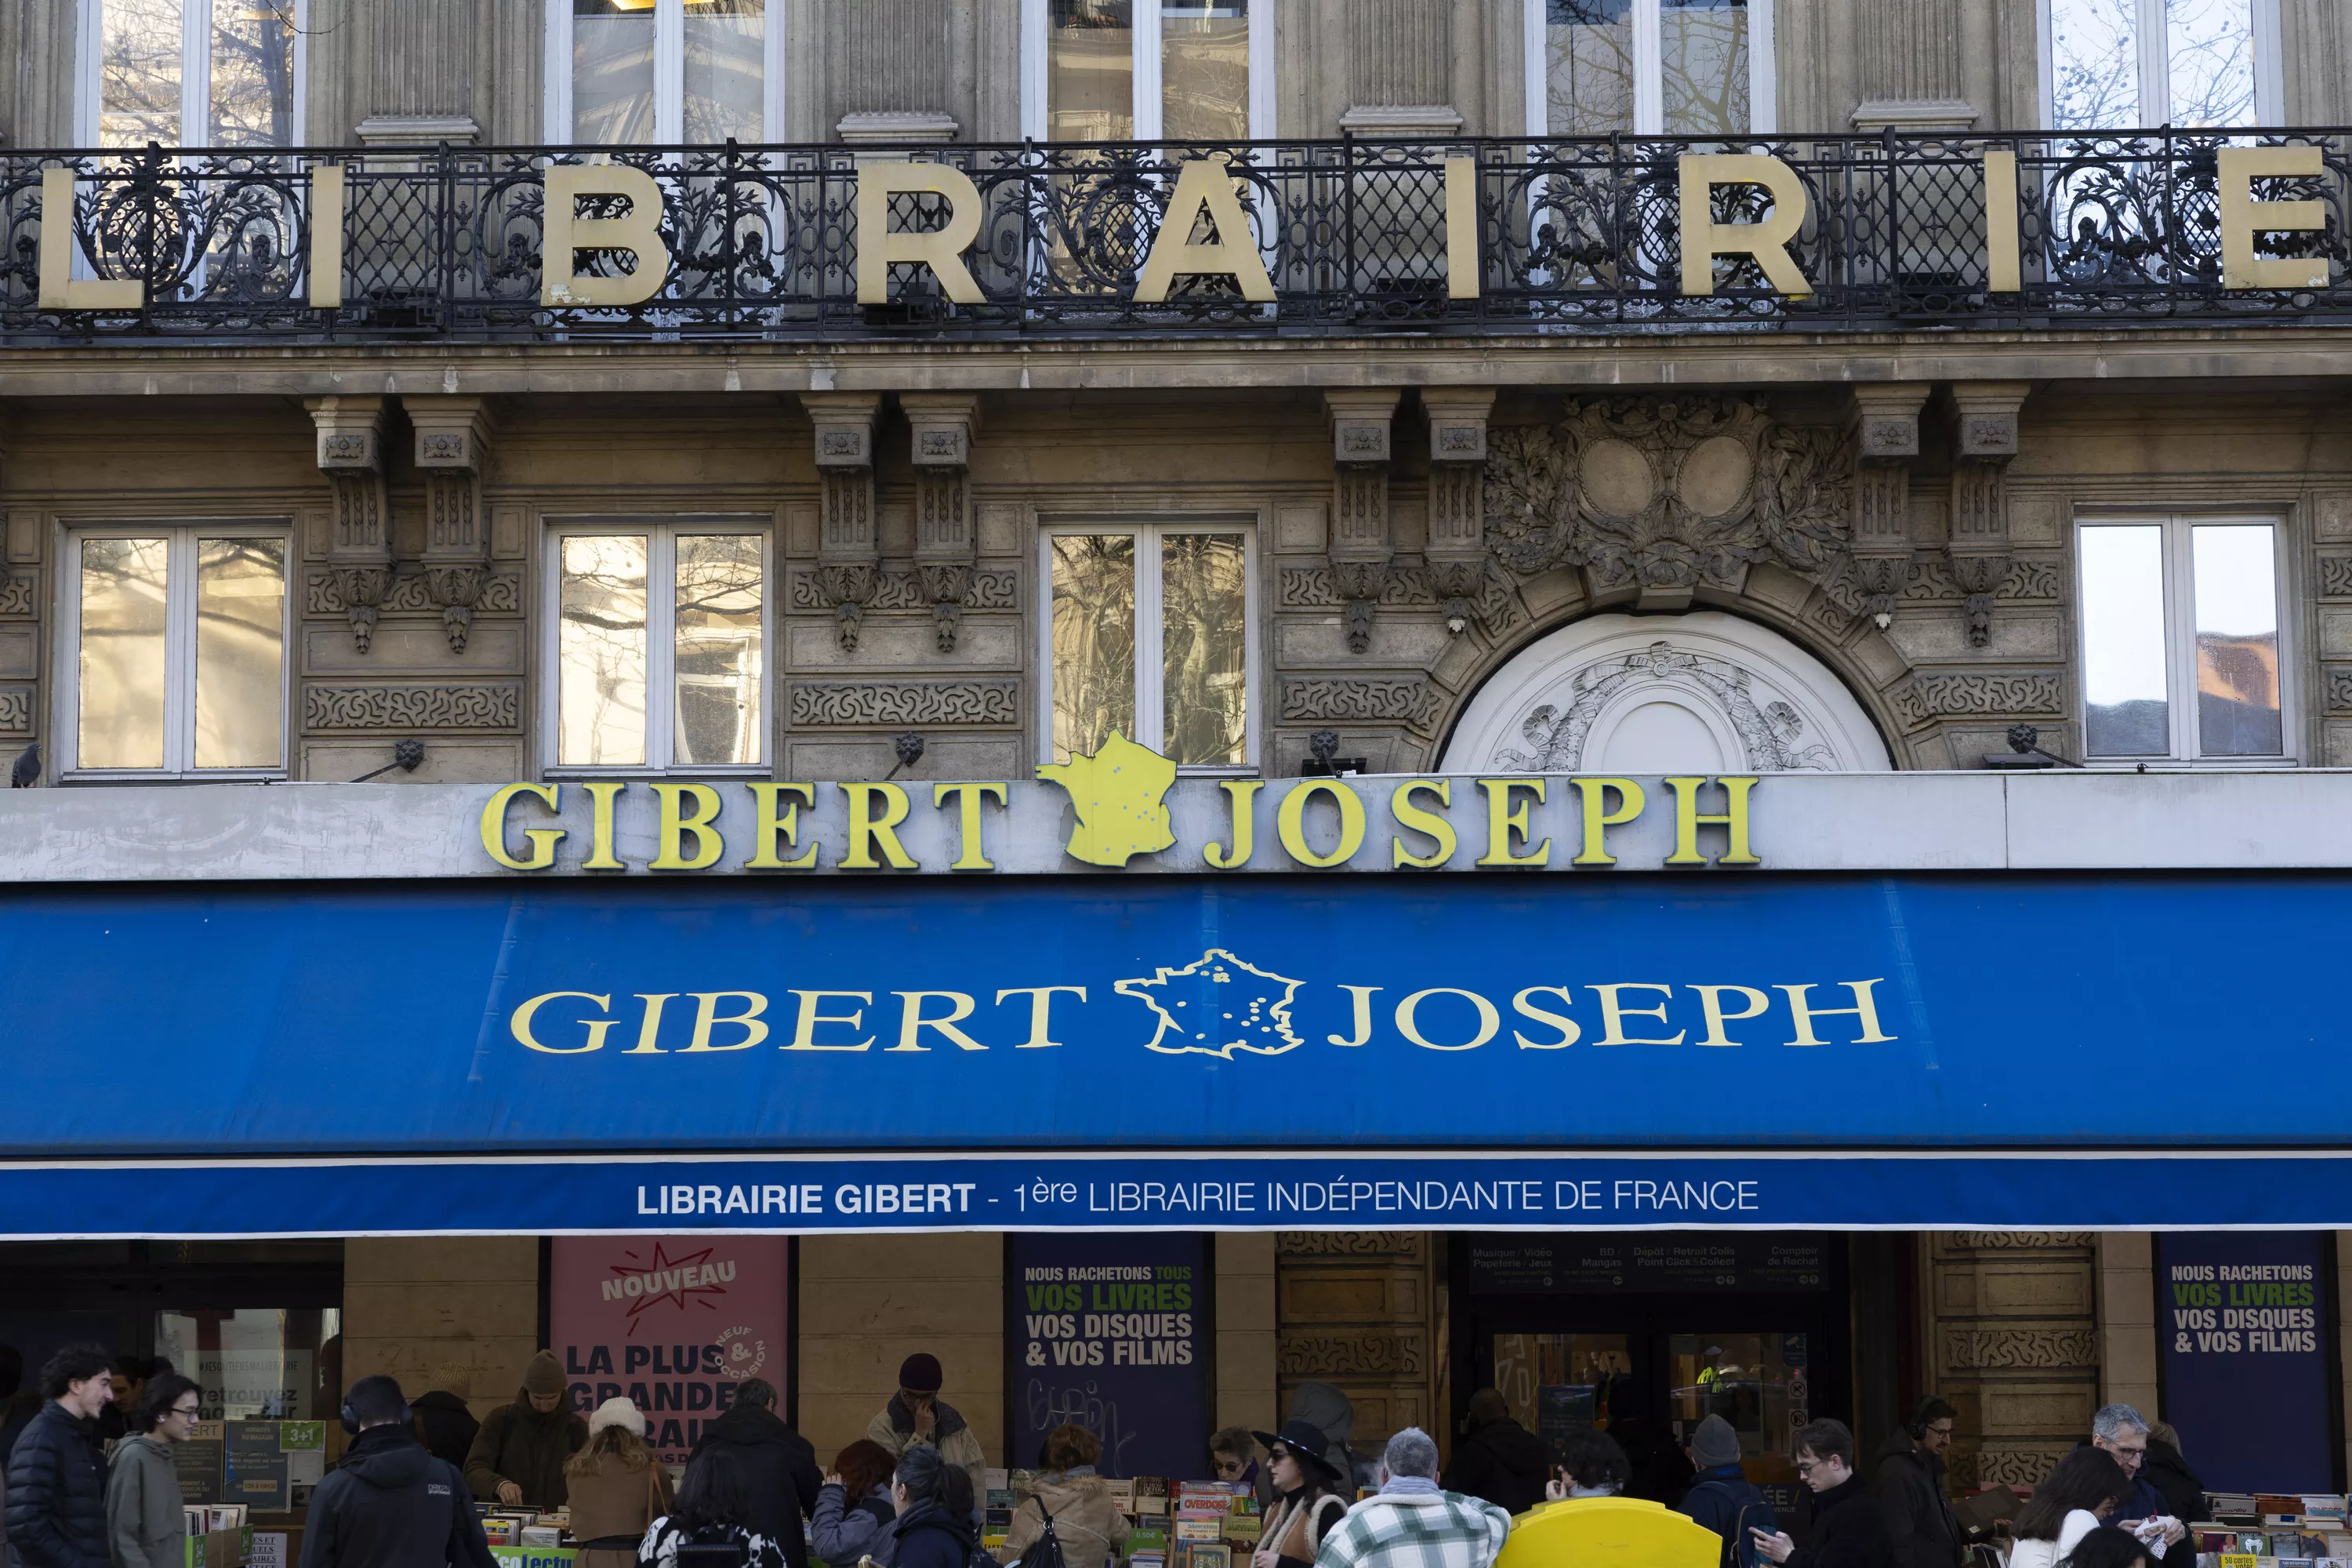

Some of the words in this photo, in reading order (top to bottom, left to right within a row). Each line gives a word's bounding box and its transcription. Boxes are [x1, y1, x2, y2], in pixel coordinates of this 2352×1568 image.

[38, 146, 2329, 310] LIBRAIRIE
[480, 782, 1009, 871] GIBERT
[1201, 775, 1762, 869] JOSEPH
[510, 985, 1087, 1054] GIBERT
[1327, 977, 1899, 1051] JOSEPH
[637, 1185, 823, 1214] LIBRAIRIE
[834, 1183, 976, 1214] GIBERT
[1013, 1176, 1078, 1213] 1ère
[1090, 1181, 1255, 1212] LIBRAIRIE
[1267, 1174, 1543, 1211] INDÉPENDANTE
[1555, 1181, 1602, 1210] DE
[1614, 1180, 1759, 1210] FRANCE
[1472, 1248, 1515, 1259] Musique
[1524, 1248, 1552, 1257] Vidéo
[1582, 1258, 1622, 1268] Mangas
[1633, 1247, 1664, 1257] Dépôt
[1673, 1247, 1708, 1255] Retrait
[1710, 1247, 1735, 1255] Colis
[1638, 1258, 1663, 1266] Point
[1666, 1258, 1691, 1266] Click
[1700, 1258, 1735, 1266] Collect
[1768, 1257, 1780, 1265] de
[1784, 1257, 1819, 1265] Rachat
[1771, 1247, 1819, 1257] Comptoir
[1025, 1268, 1064, 1281] NOUS
[1068, 1267, 1152, 1281] RACHETONS
[1155, 1266, 1192, 1279] TOUS
[1473, 1258, 1521, 1269] Papeterie
[1529, 1258, 1553, 1267] Jeux
[2172, 1265, 2214, 1281] NOUS
[2220, 1265, 2313, 1281] RACHETONS
[601, 1261, 736, 1301] NOUVEAU
[1025, 1283, 1083, 1312] VOS
[1093, 1283, 1192, 1311] LIVRES
[2173, 1283, 2222, 1307] VOS
[2230, 1283, 2314, 1306] LIVRES
[1025, 1314, 1076, 1338] VOS
[1084, 1313, 1192, 1340] DISQUES
[2174, 1308, 2216, 1330] VOS
[2223, 1308, 2315, 1332] DISQUES
[715, 1326, 753, 1348] NEUF
[2175, 1331, 2193, 1352] &
[2197, 1331, 2241, 1352] VOS
[2249, 1330, 2317, 1352] FILMS
[567, 1345, 614, 1374] LA
[625, 1345, 725, 1374] PLUS
[715, 1339, 765, 1380] OCCASION
[731, 1343, 753, 1362] &
[1025, 1341, 1047, 1367] &
[1052, 1341, 1104, 1366] VOS
[1113, 1340, 1192, 1365] FILMS
[201, 1387, 298, 1403] retrouvez
[568, 1382, 738, 1412] GRANDE
[191, 1425, 219, 1436] ERT
[290, 1428, 314, 1442] 3+1
